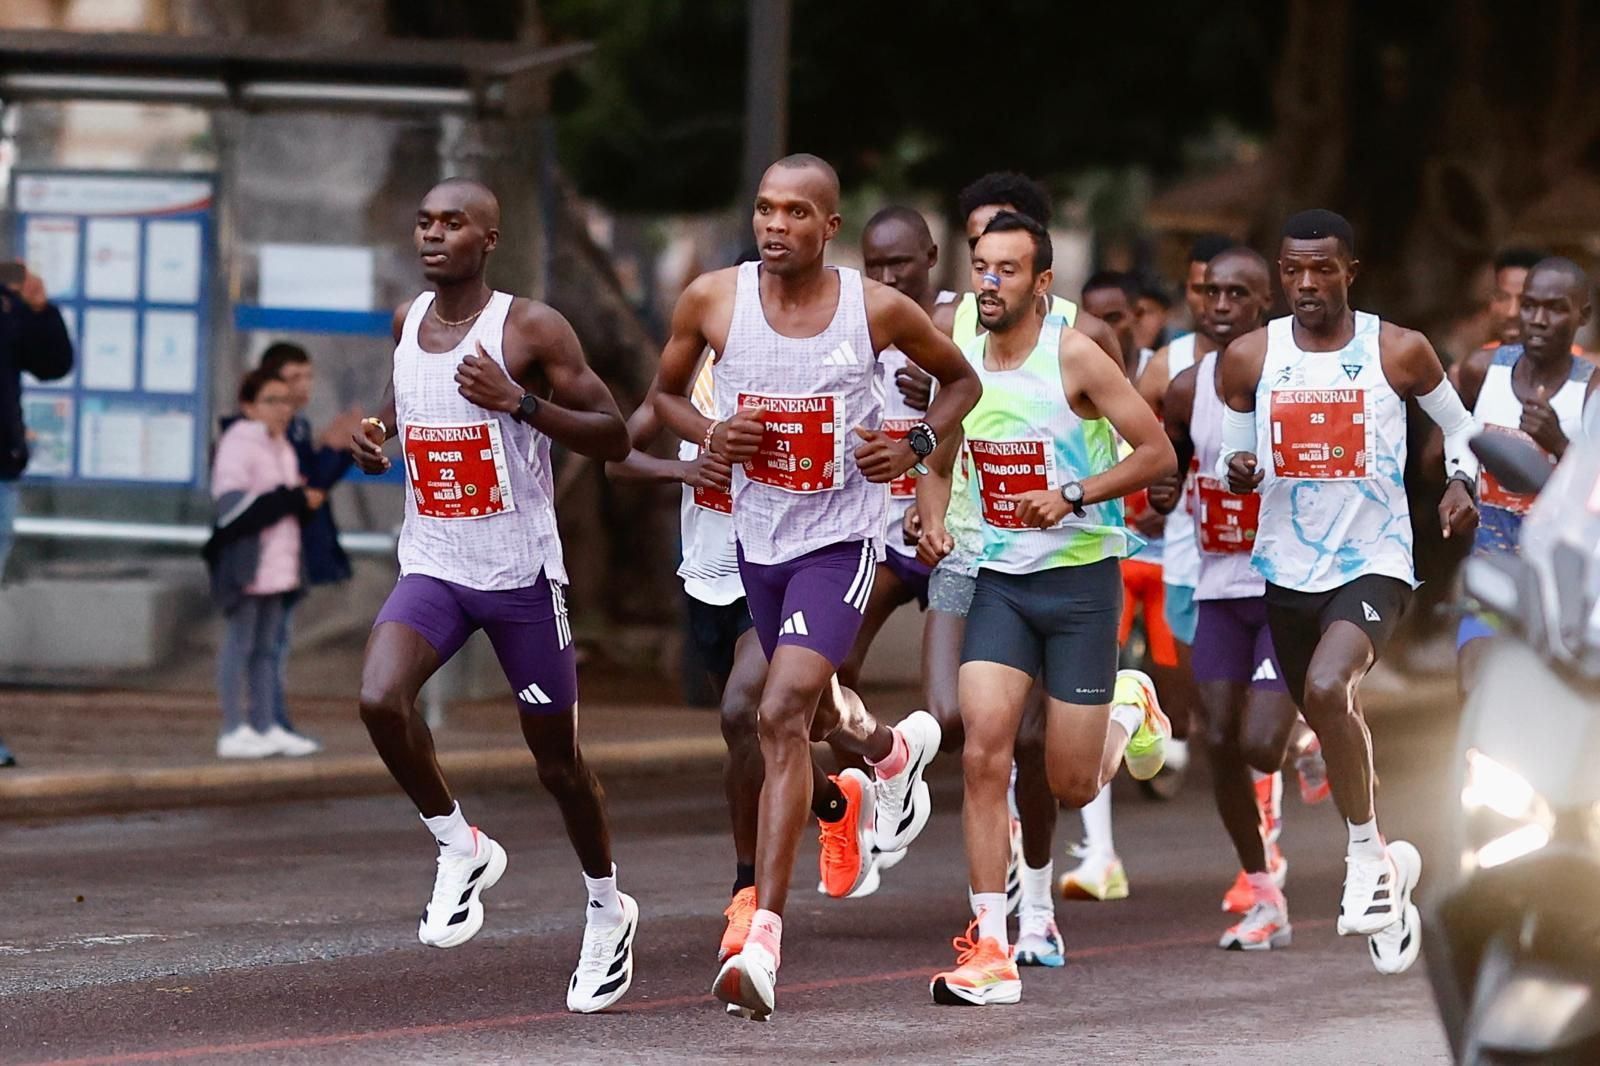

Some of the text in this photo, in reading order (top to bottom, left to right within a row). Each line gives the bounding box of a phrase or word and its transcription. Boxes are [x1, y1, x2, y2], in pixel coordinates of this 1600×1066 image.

[1295, 391, 1357, 403] GENERALI
[761, 398, 826, 412] GENERALI
[1310, 413, 1325, 424] 25
[766, 422, 802, 433] PACER
[422, 427, 481, 441] GENERALI
[776, 440, 789, 452] 21
[985, 443, 1037, 455] GENERALI
[428, 451, 462, 461] PACER
[440, 469, 454, 480] 22
[999, 482, 1005, 492] 4
